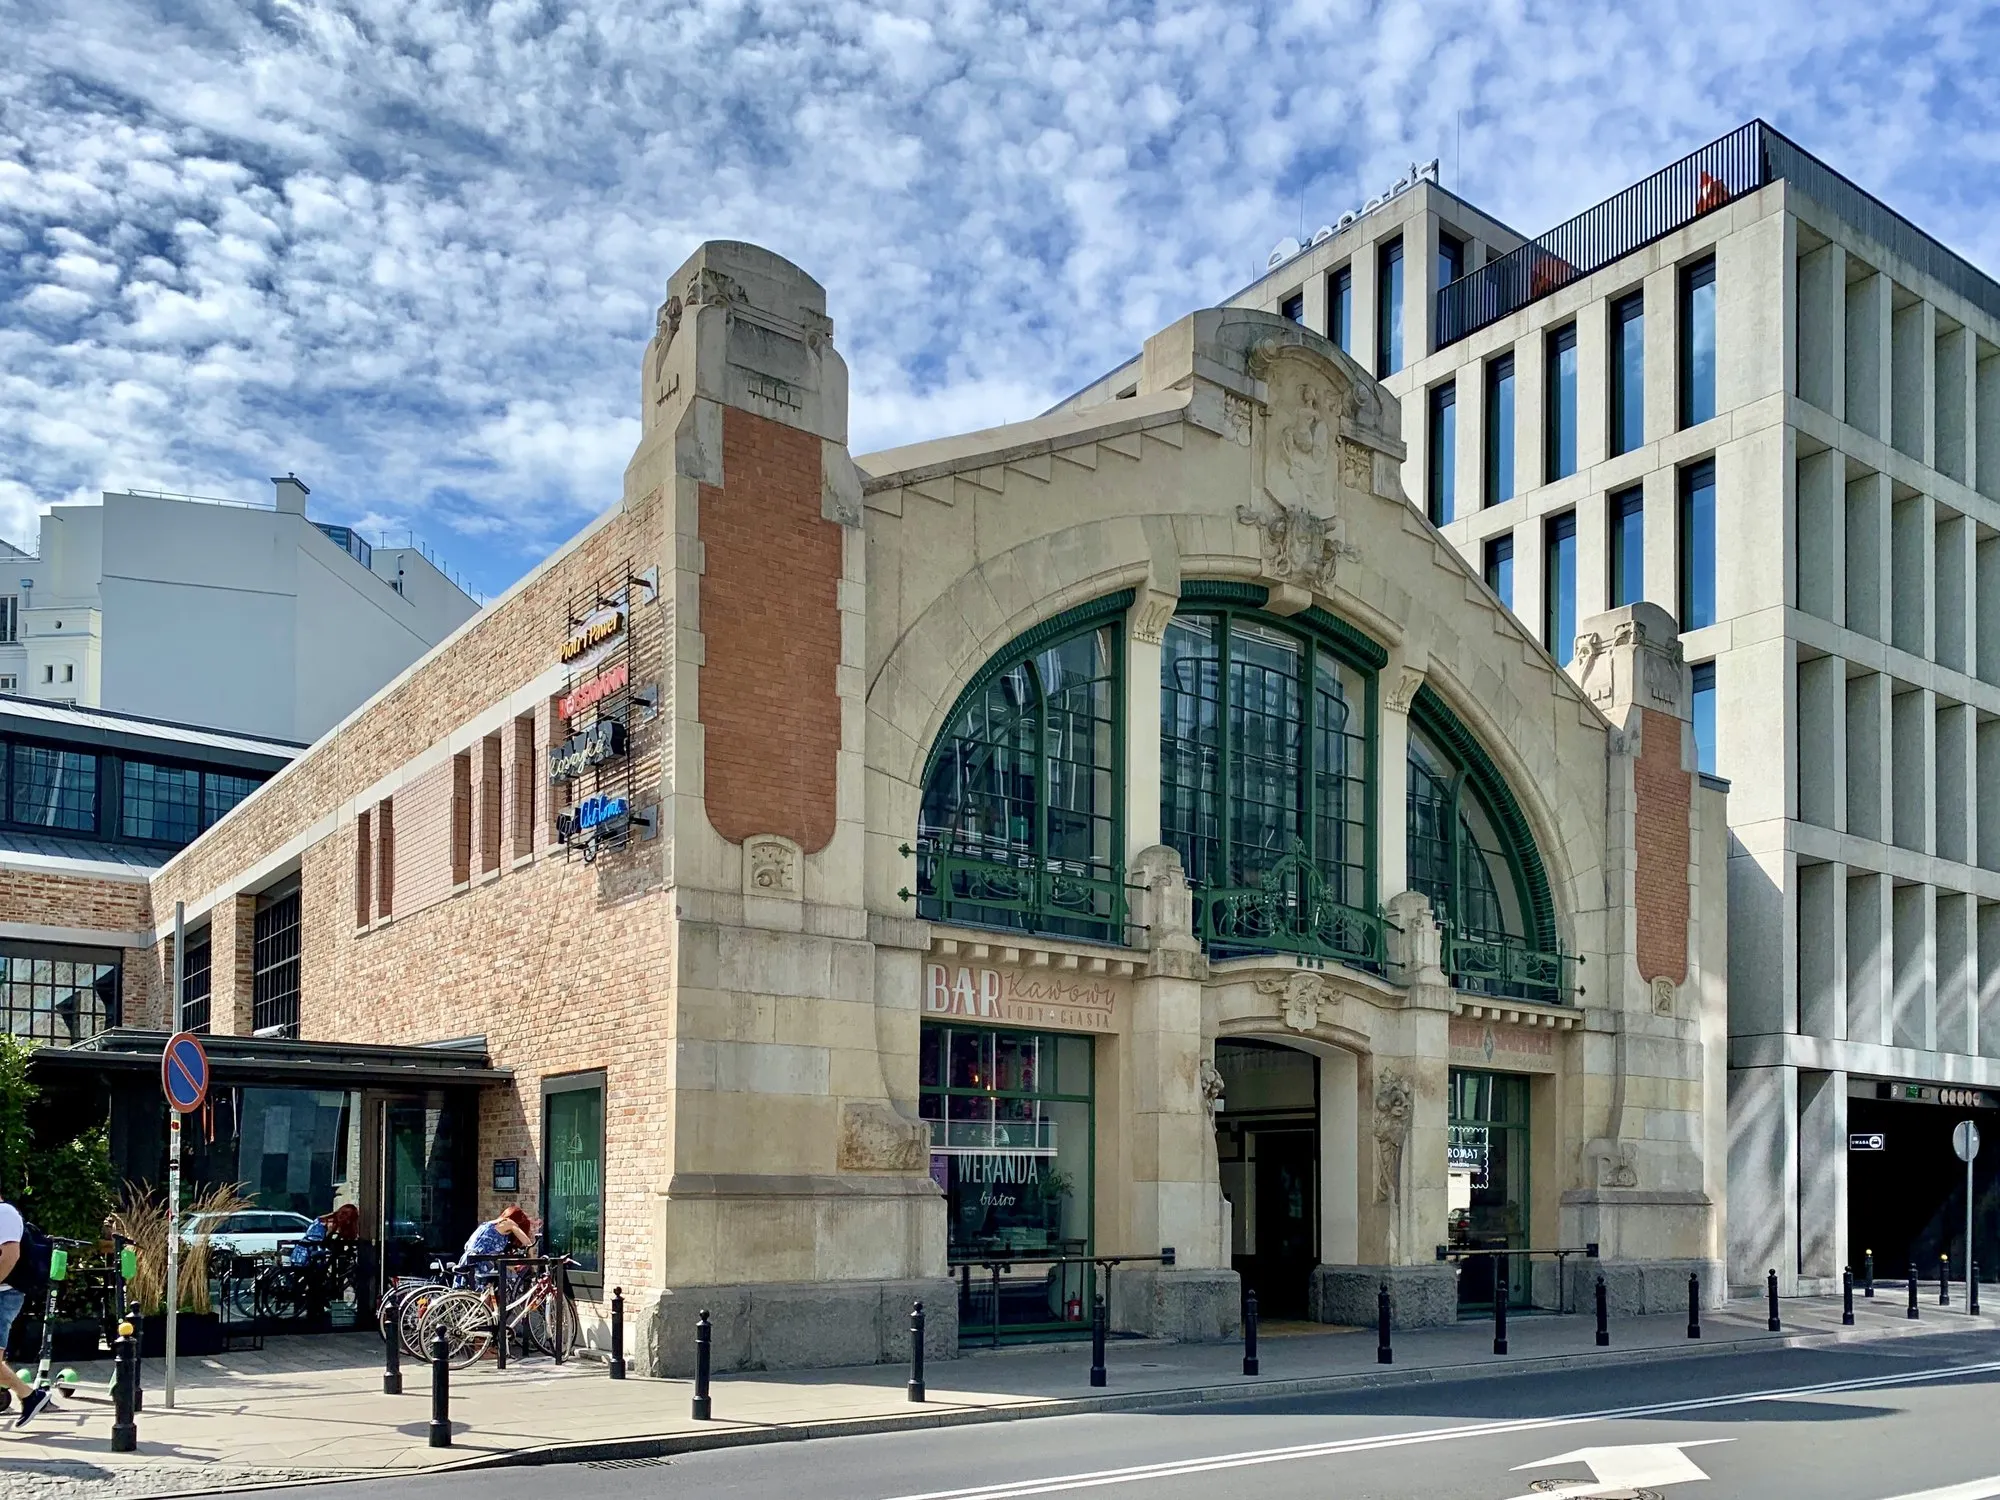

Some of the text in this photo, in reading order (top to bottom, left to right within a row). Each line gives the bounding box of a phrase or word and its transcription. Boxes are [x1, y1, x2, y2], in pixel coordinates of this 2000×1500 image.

[560, 637, 581, 662] Piotr
[927, 963, 1001, 1018] BAR
[1004, 972, 1115, 1008] Kawowy
[1008, 1005, 1043, 1022] LODY
[554, 1159, 599, 1196] WERANDA
[958, 1151, 1039, 1184] WERANDA
[979, 1191, 1017, 1207] bistro
